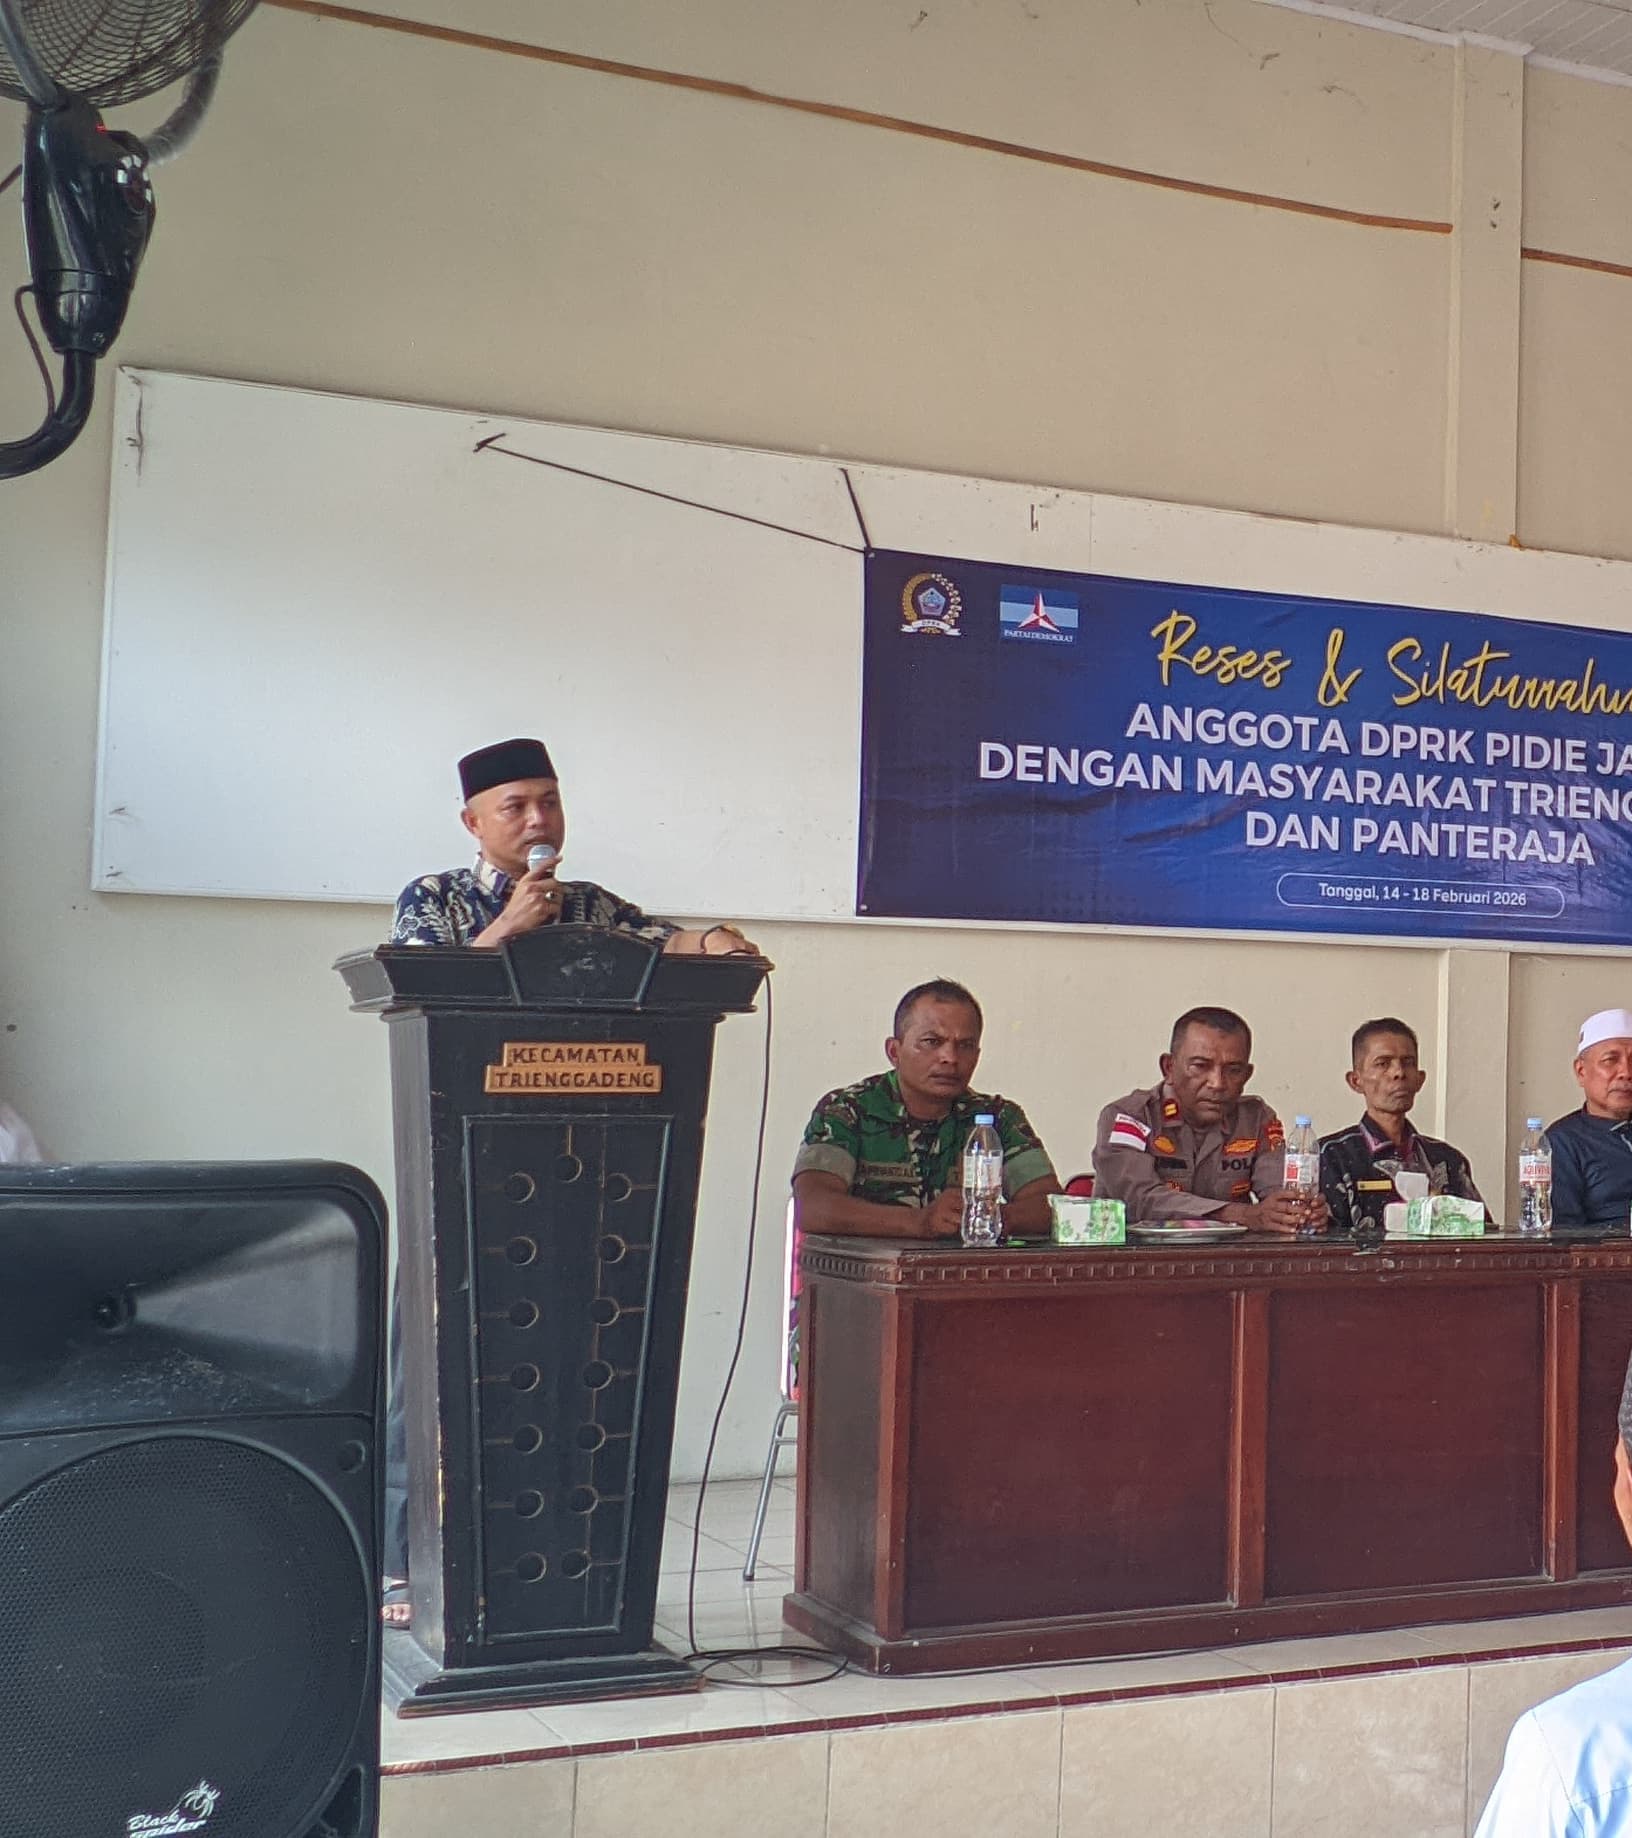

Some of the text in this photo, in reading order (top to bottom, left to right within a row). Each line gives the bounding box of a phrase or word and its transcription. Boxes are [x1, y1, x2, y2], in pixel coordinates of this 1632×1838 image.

[1004, 629, 1073, 643] PARTAI DEMOKRAT
[1151, 609, 1292, 688] Reses
[1317, 628, 1363, 707] &
[1126, 703, 1350, 755] ANGGOTA
[1361, 721, 1475, 765] DPRK
[1486, 732, 1588, 773] PIDIE
[980, 742, 1182, 792] DENGAN
[1197, 758, 1497, 812] MASYARAKAT
[1246, 811, 1596, 866] DAN PANTERAJA
[1319, 882, 1379, 901] Tanggal,
[1383, 886, 1400, 900] 14
[1413, 888, 1429, 901] 18
[1433, 888, 1490, 905] Februari
[1493, 891, 1527, 906] 2026
[513, 1047, 640, 1064] KECAMATAN
[496, 1072, 655, 1088] TRIENGGADENG
[1221, 1157, 1255, 1171] POL
[127, 1808, 180, 1831] Black
